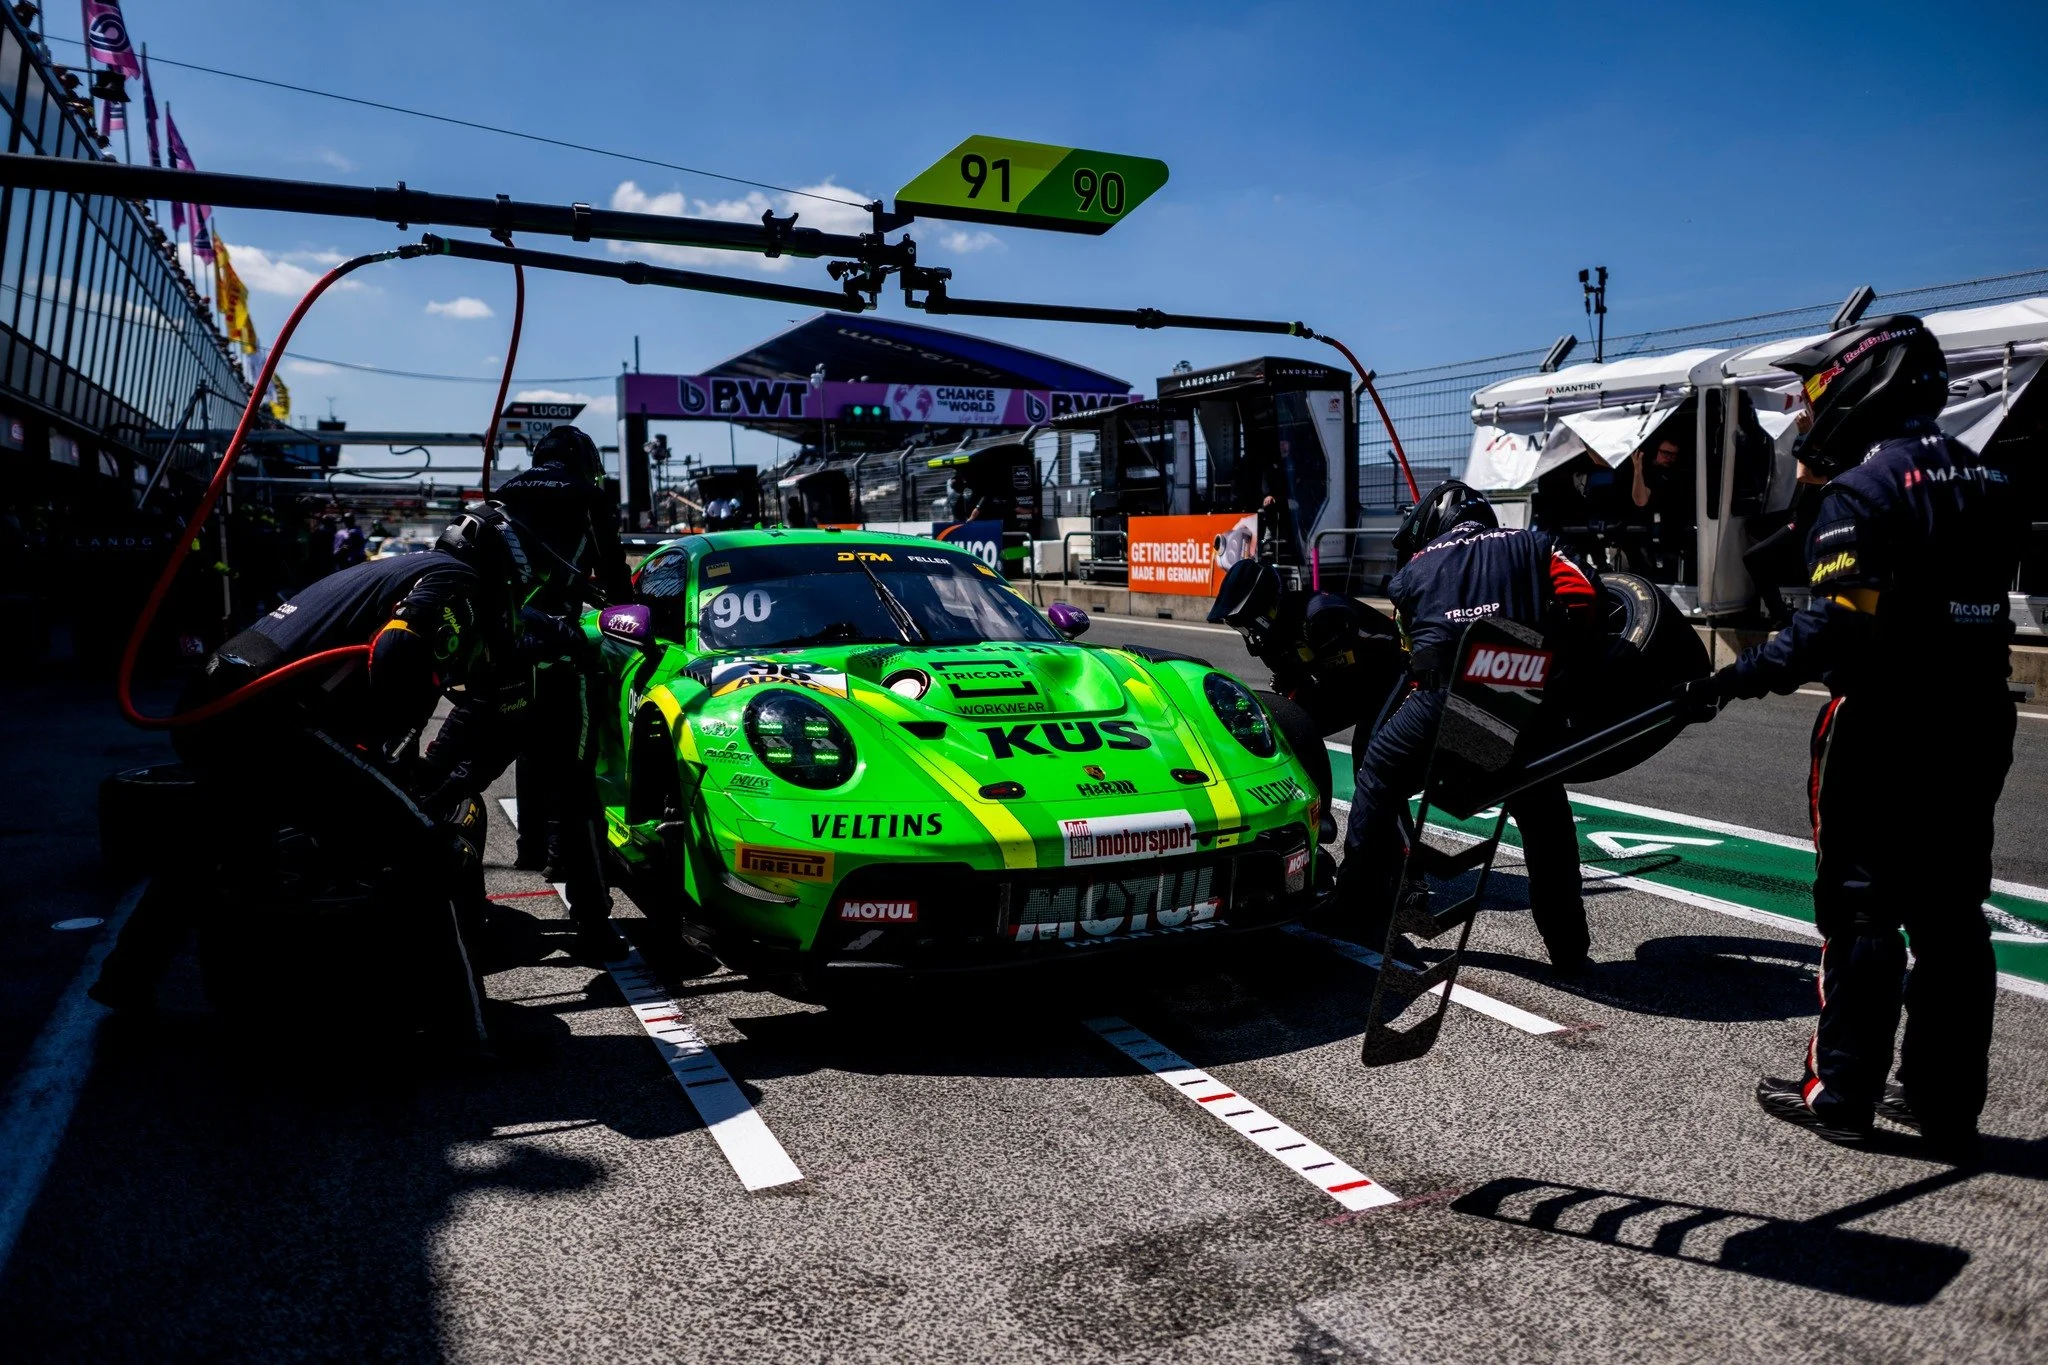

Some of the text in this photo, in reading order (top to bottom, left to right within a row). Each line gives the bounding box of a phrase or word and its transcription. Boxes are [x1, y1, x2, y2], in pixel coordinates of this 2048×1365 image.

[961, 154, 1124, 216] 91 90
[936, 388, 994, 401] CHANGE
[1556, 383, 1602, 394] MANTHEY
[710, 377, 811, 418] BWT
[950, 401, 995, 412] WORLD
[526, 421, 552, 432] TOM
[837, 552, 893, 562] DTM
[1131, 538, 1211, 564] GETRIEBEÖLE
[907, 555, 951, 565] FELLER
[1131, 566, 1210, 584] MADE IN GERMANY
[713, 589, 772, 628] 90
[1445, 602, 1500, 620] TRICORP
[1466, 649, 1546, 682] MOTUL
[940, 670, 1025, 681] TRICORP
[958, 701, 1046, 715] WORKWEAR
[976, 720, 1152, 760] KÜS
[704, 749, 753, 761] PADDOCK
[730, 774, 771, 787] ENDLESS
[811, 813, 943, 839] VELTINS
[1067, 822, 1091, 836] Auto
[1096, 823, 1192, 857] motorsport
[742, 848, 826, 877] PIRELLI
[841, 902, 914, 919] MOTUL
[1015, 866, 1219, 941] MOTUL
